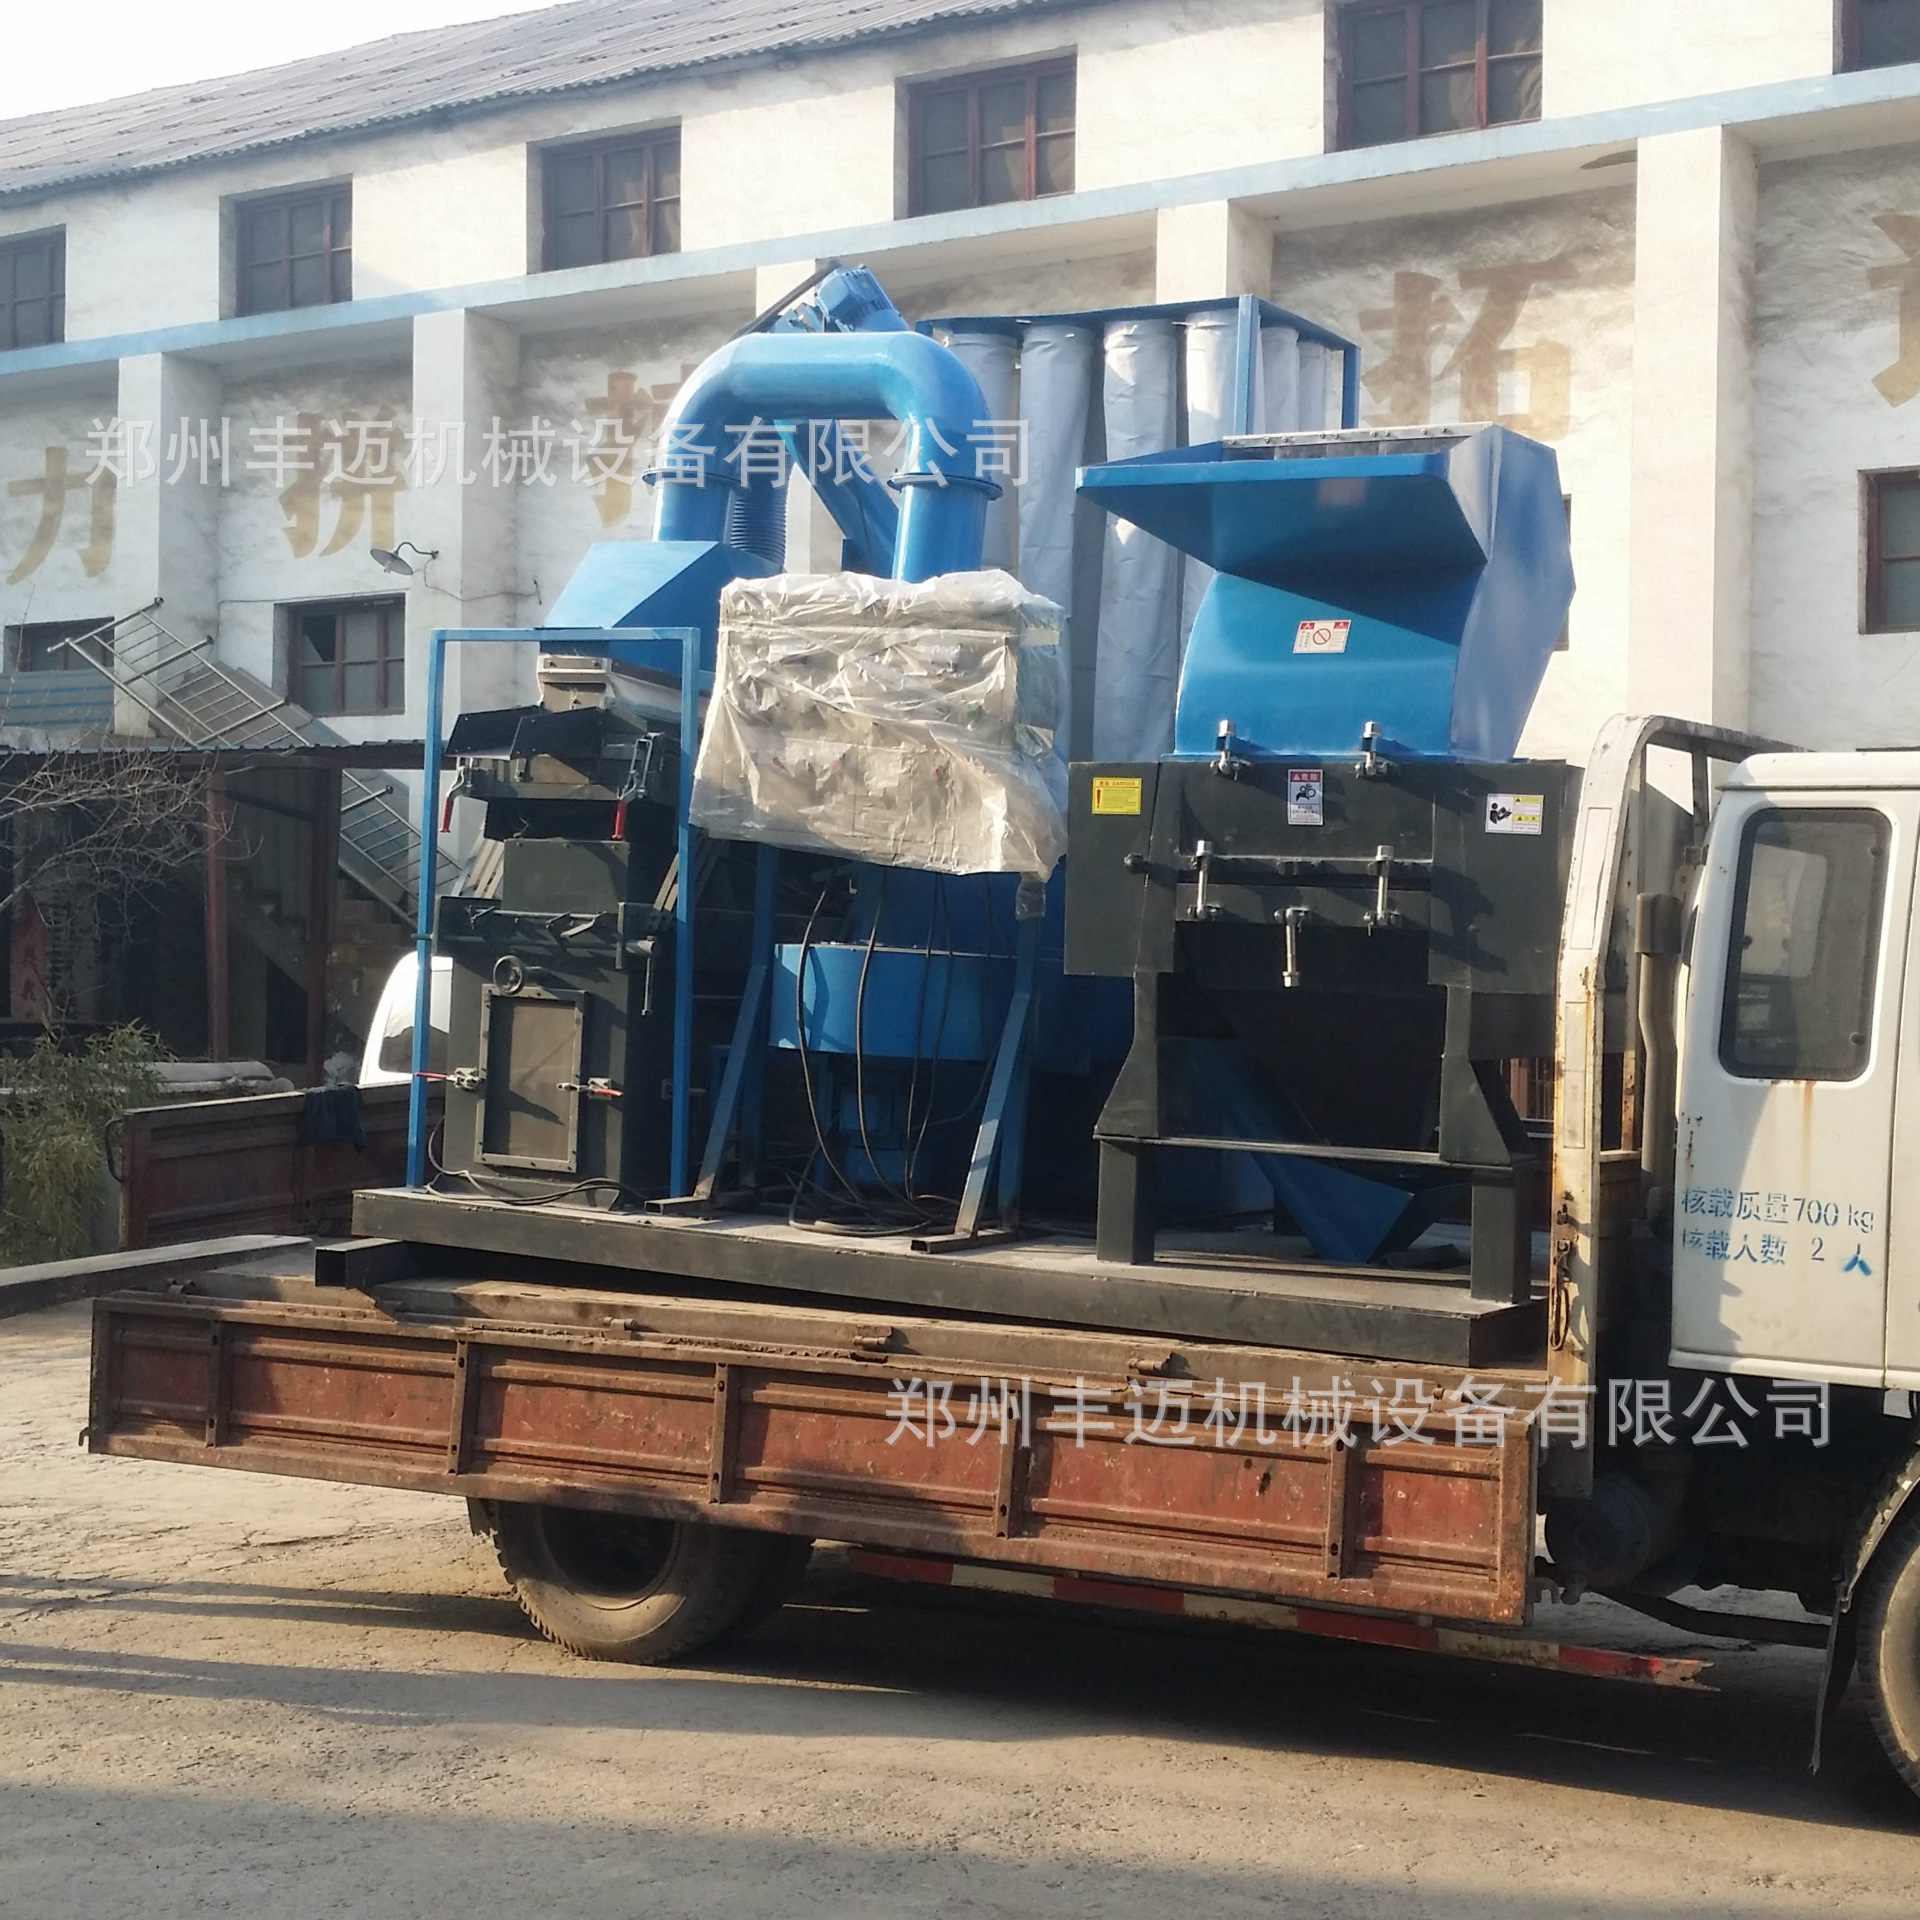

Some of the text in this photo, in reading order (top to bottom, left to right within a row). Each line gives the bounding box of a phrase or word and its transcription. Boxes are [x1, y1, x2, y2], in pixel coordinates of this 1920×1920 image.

[8, 447, 115, 585] 力
[1681, 1227, 1874, 1277] 核载人数 2 人
